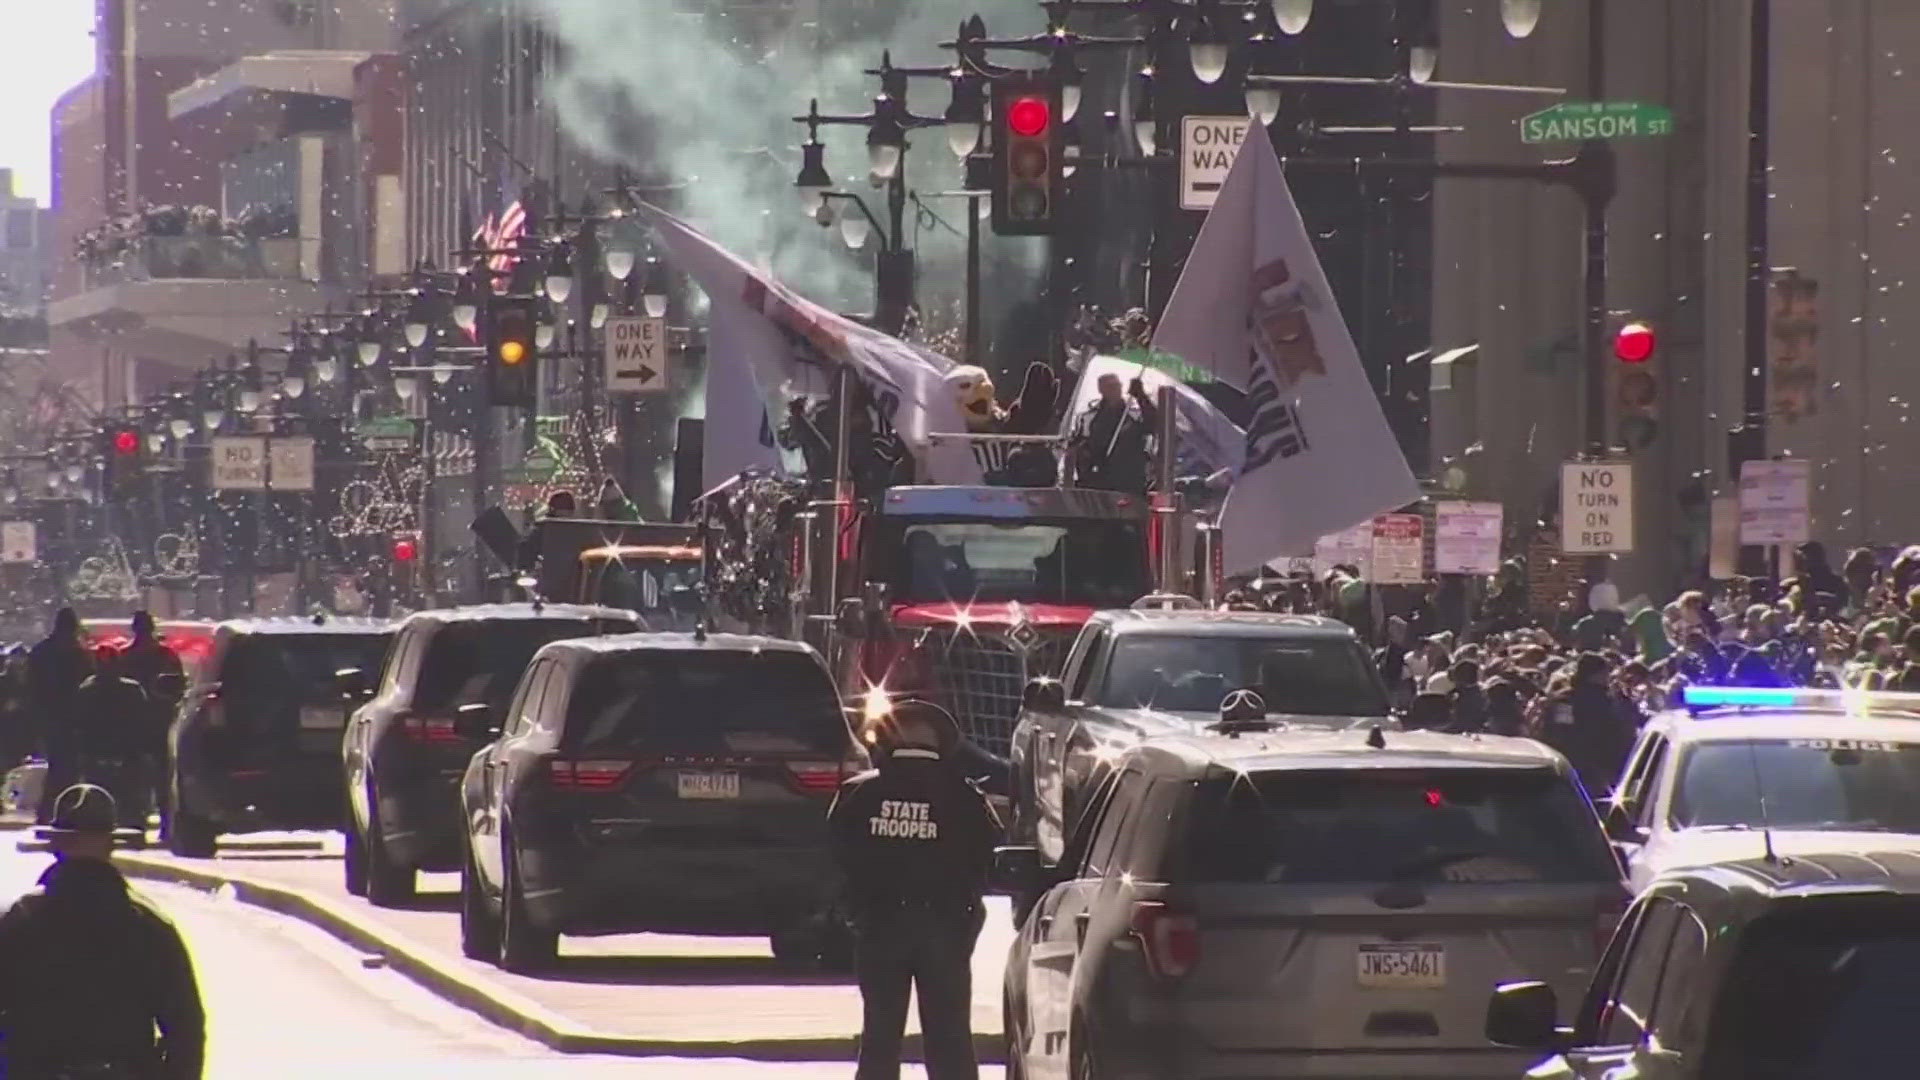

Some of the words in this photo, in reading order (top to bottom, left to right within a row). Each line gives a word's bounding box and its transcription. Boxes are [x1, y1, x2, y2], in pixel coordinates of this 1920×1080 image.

[1193, 125, 1245, 145] ONE
[1530, 115, 1637, 140] SANSOM
[1648, 120, 1667, 135] ST
[616, 323, 653, 339] ONE
[615, 343, 654, 359] WAY
[225, 446, 252, 462] NO
[1581, 470, 1613, 488] NO
[1578, 493, 1619, 507] TURN
[1585, 513, 1609, 527] ON
[1581, 531, 1614, 546] RED
[1788, 739, 1901, 752] POLICE
[881, 800, 930, 820] STATE
[869, 816, 938, 839] TROOPER
